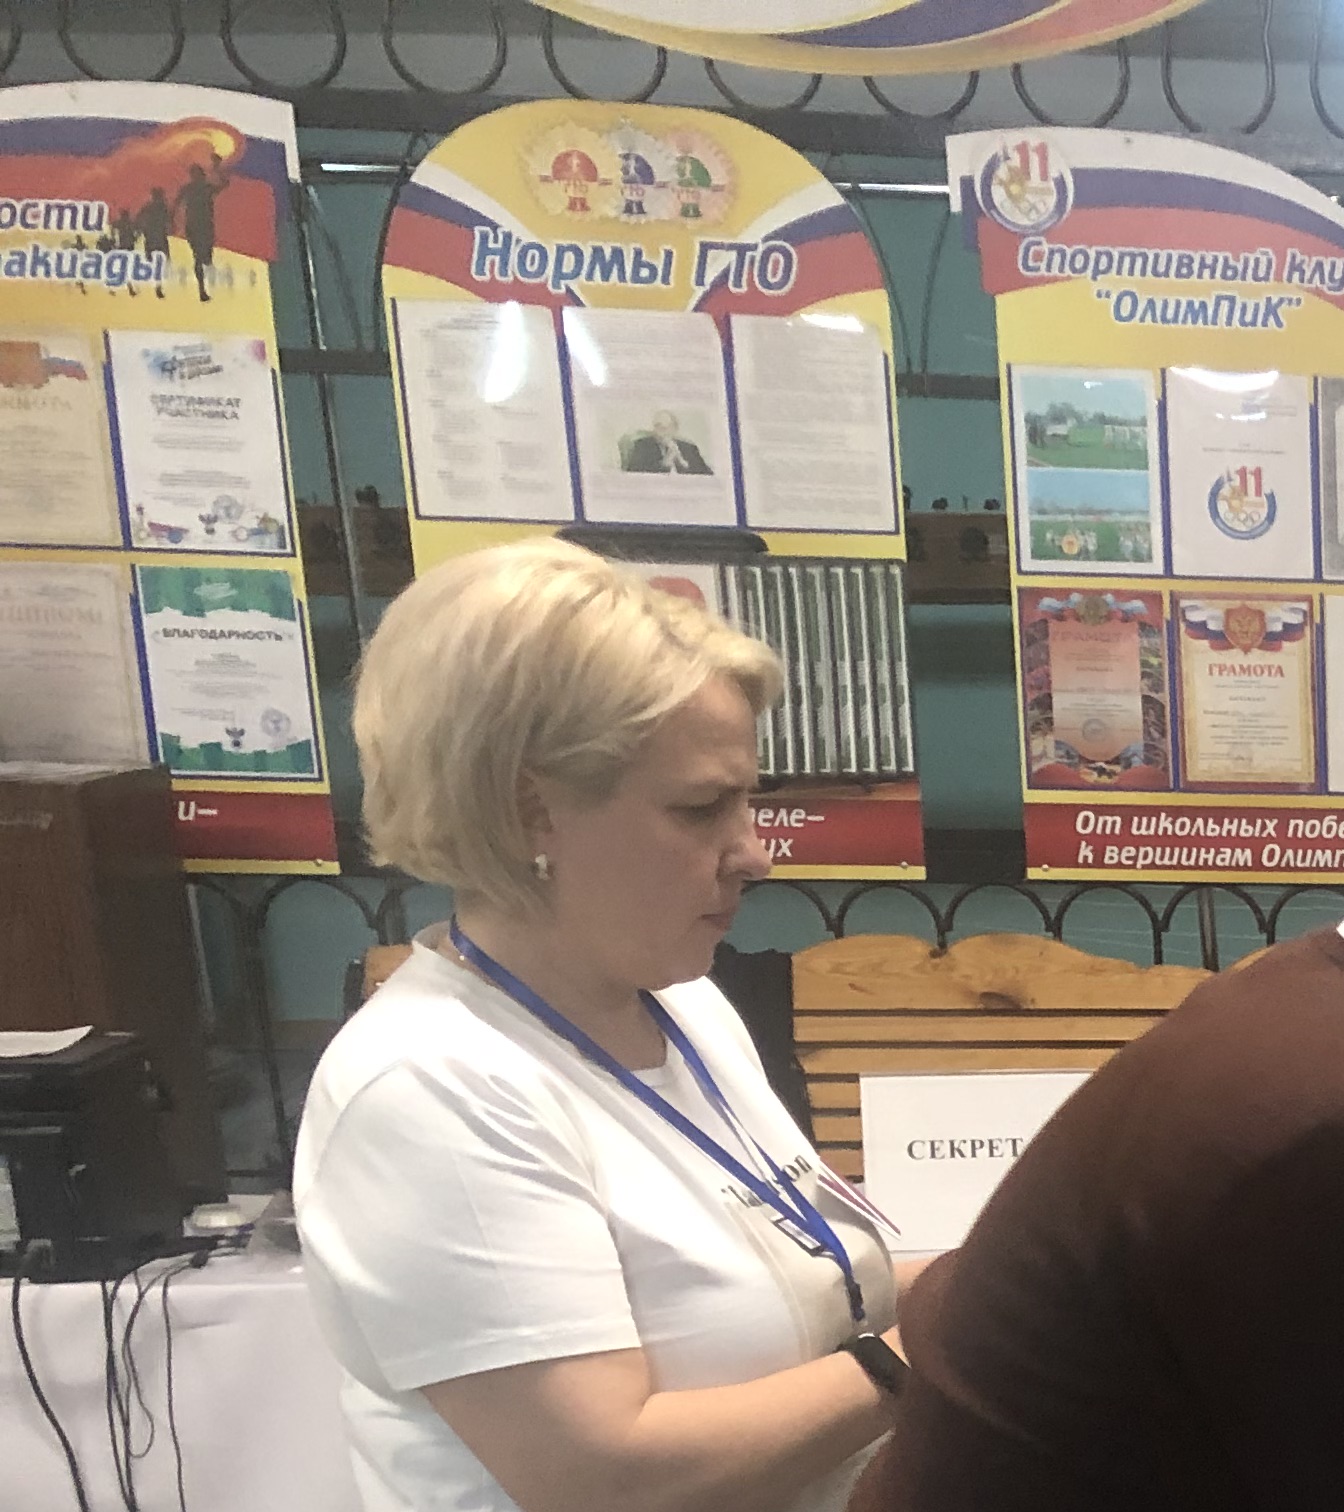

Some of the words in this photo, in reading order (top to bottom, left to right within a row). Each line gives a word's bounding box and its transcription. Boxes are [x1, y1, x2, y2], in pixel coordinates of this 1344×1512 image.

[0, 243, 164, 287] акиады
[473, 228, 674, 290] Нормы
[695, 240, 796, 291] ГТО
[1019, 239, 1272, 282] Спортивный
[1208, 662, 1285, 679] ГРАМОТА
[1075, 809, 1122, 835] От
[1130, 812, 1279, 838] школьных
[1103, 845, 1252, 869] вершинам
[906, 1137, 1024, 1161] СЕКРЕТ
